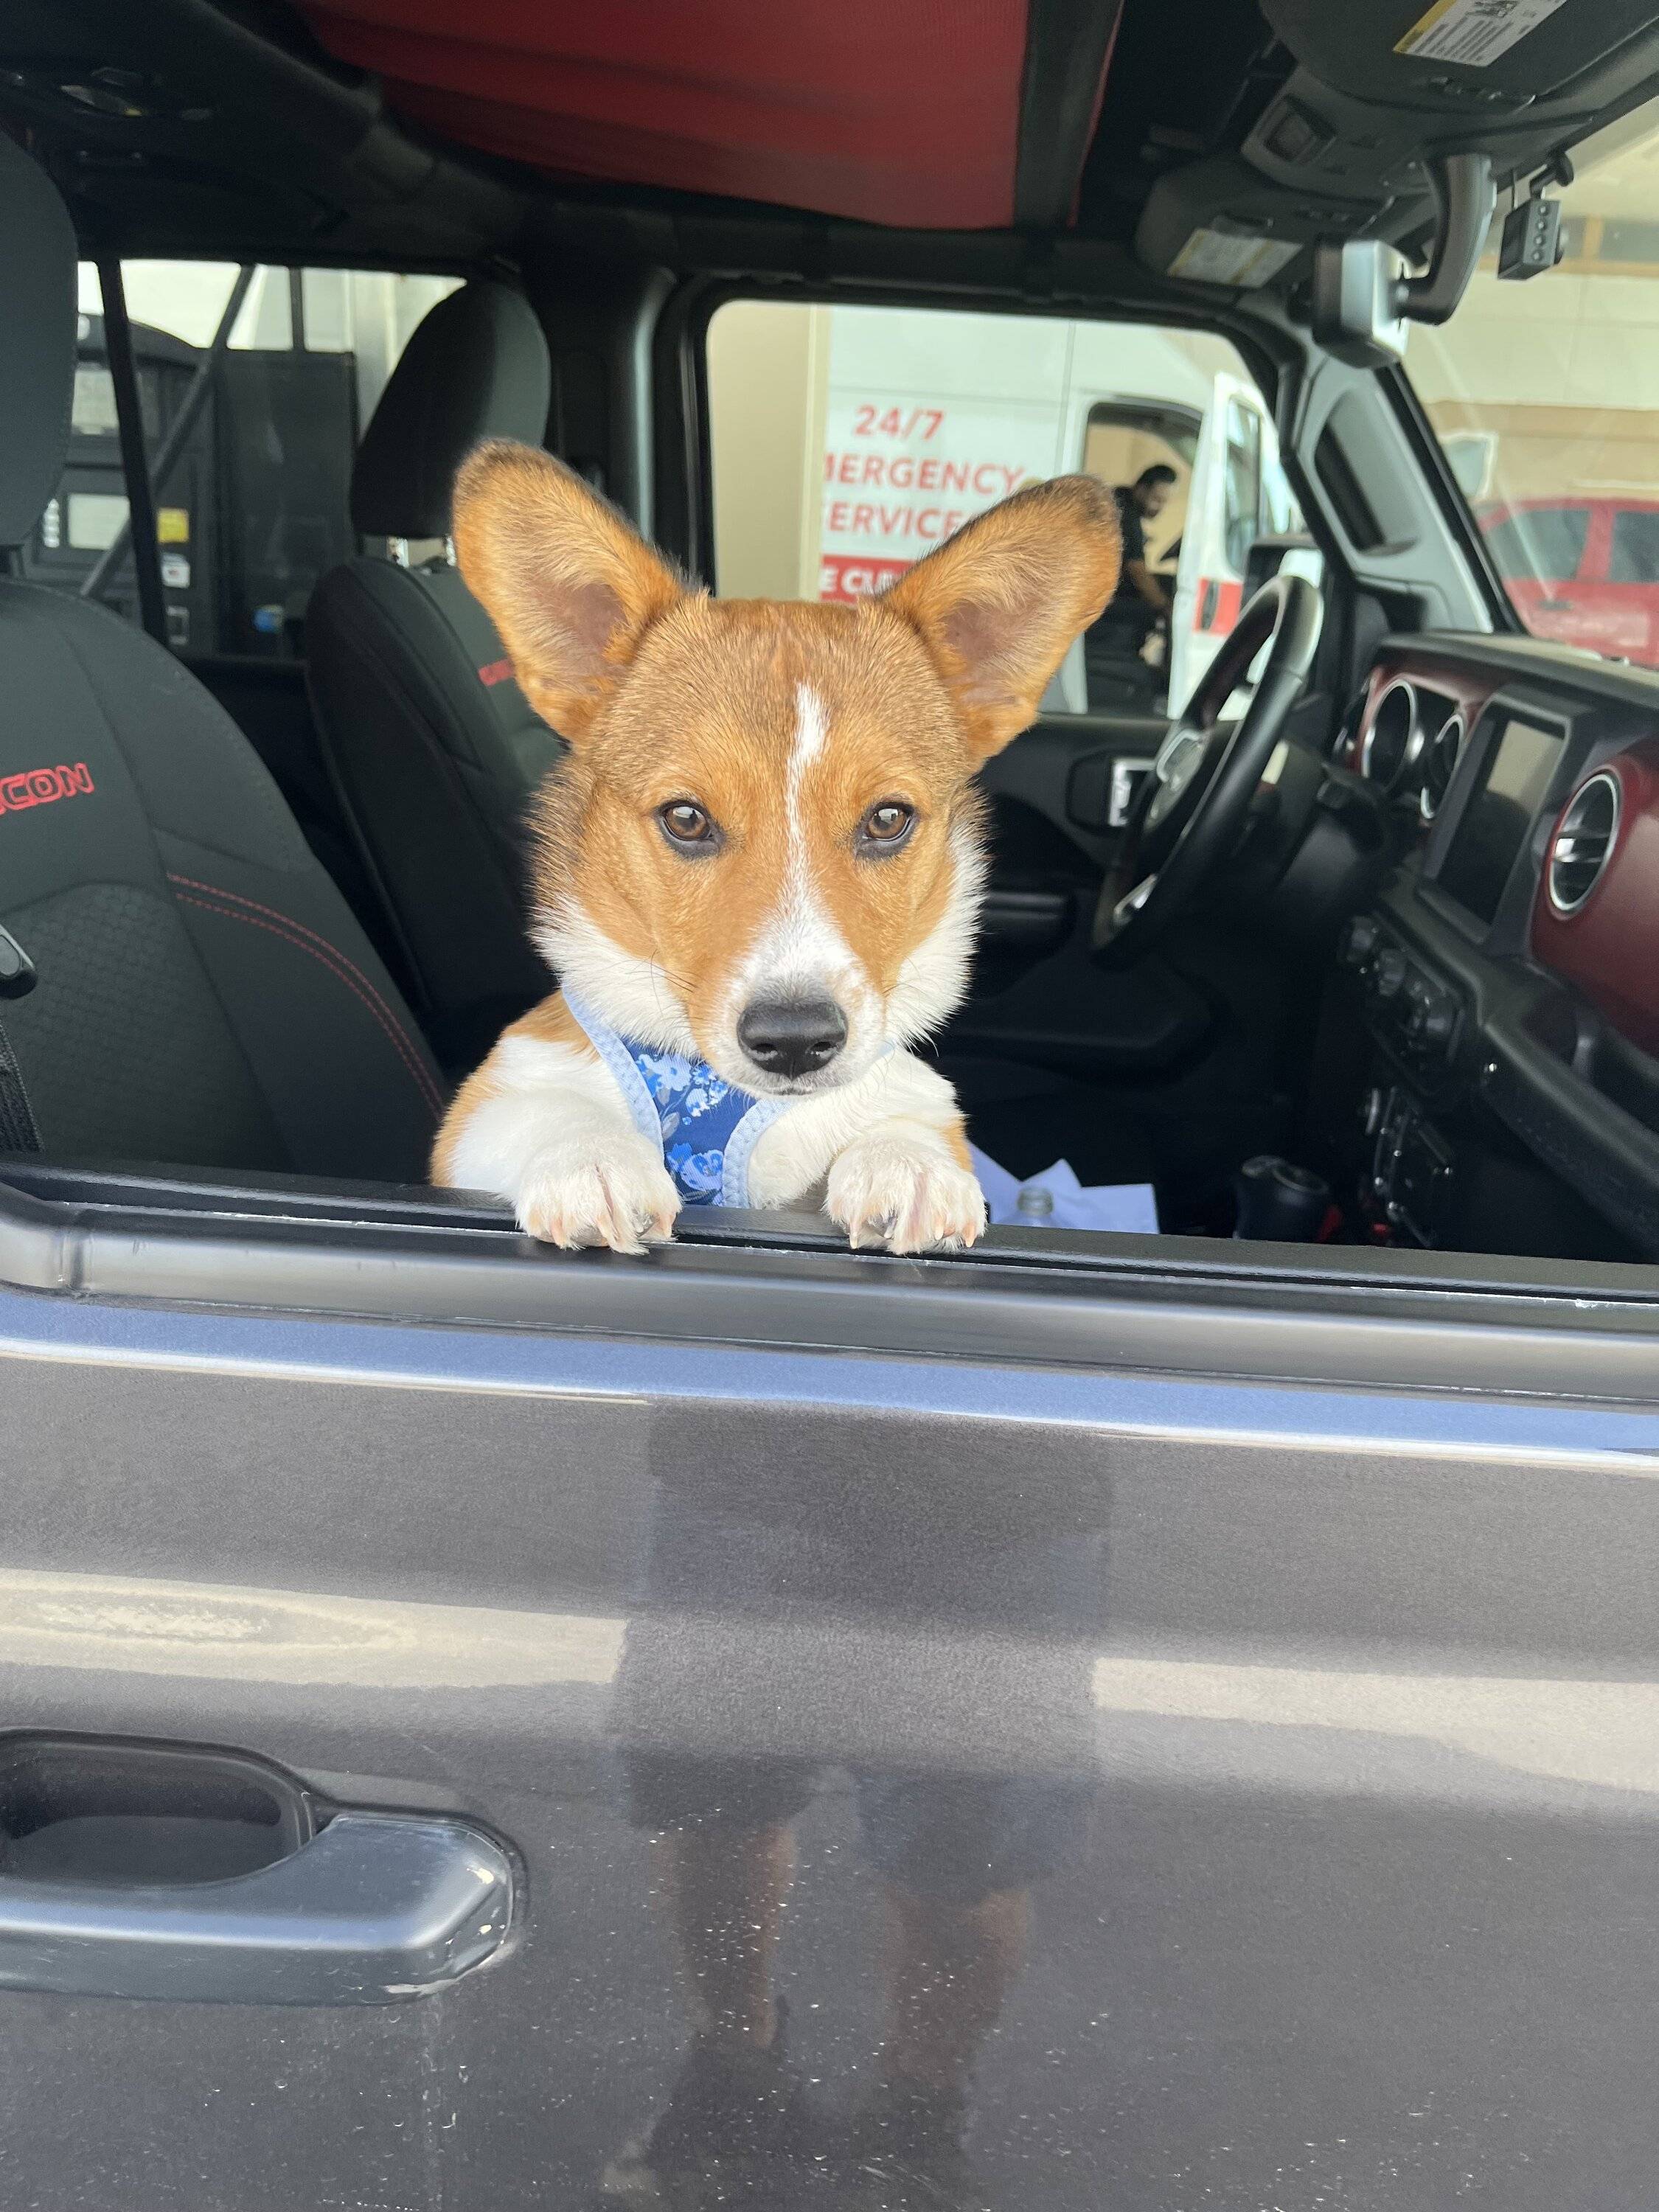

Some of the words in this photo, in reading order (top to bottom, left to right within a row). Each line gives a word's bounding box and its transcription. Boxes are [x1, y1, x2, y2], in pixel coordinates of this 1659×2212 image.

[854, 403, 944, 442] 24/7
[829, 501, 964, 542] ERVICE
[0, 761, 95, 815] CON
